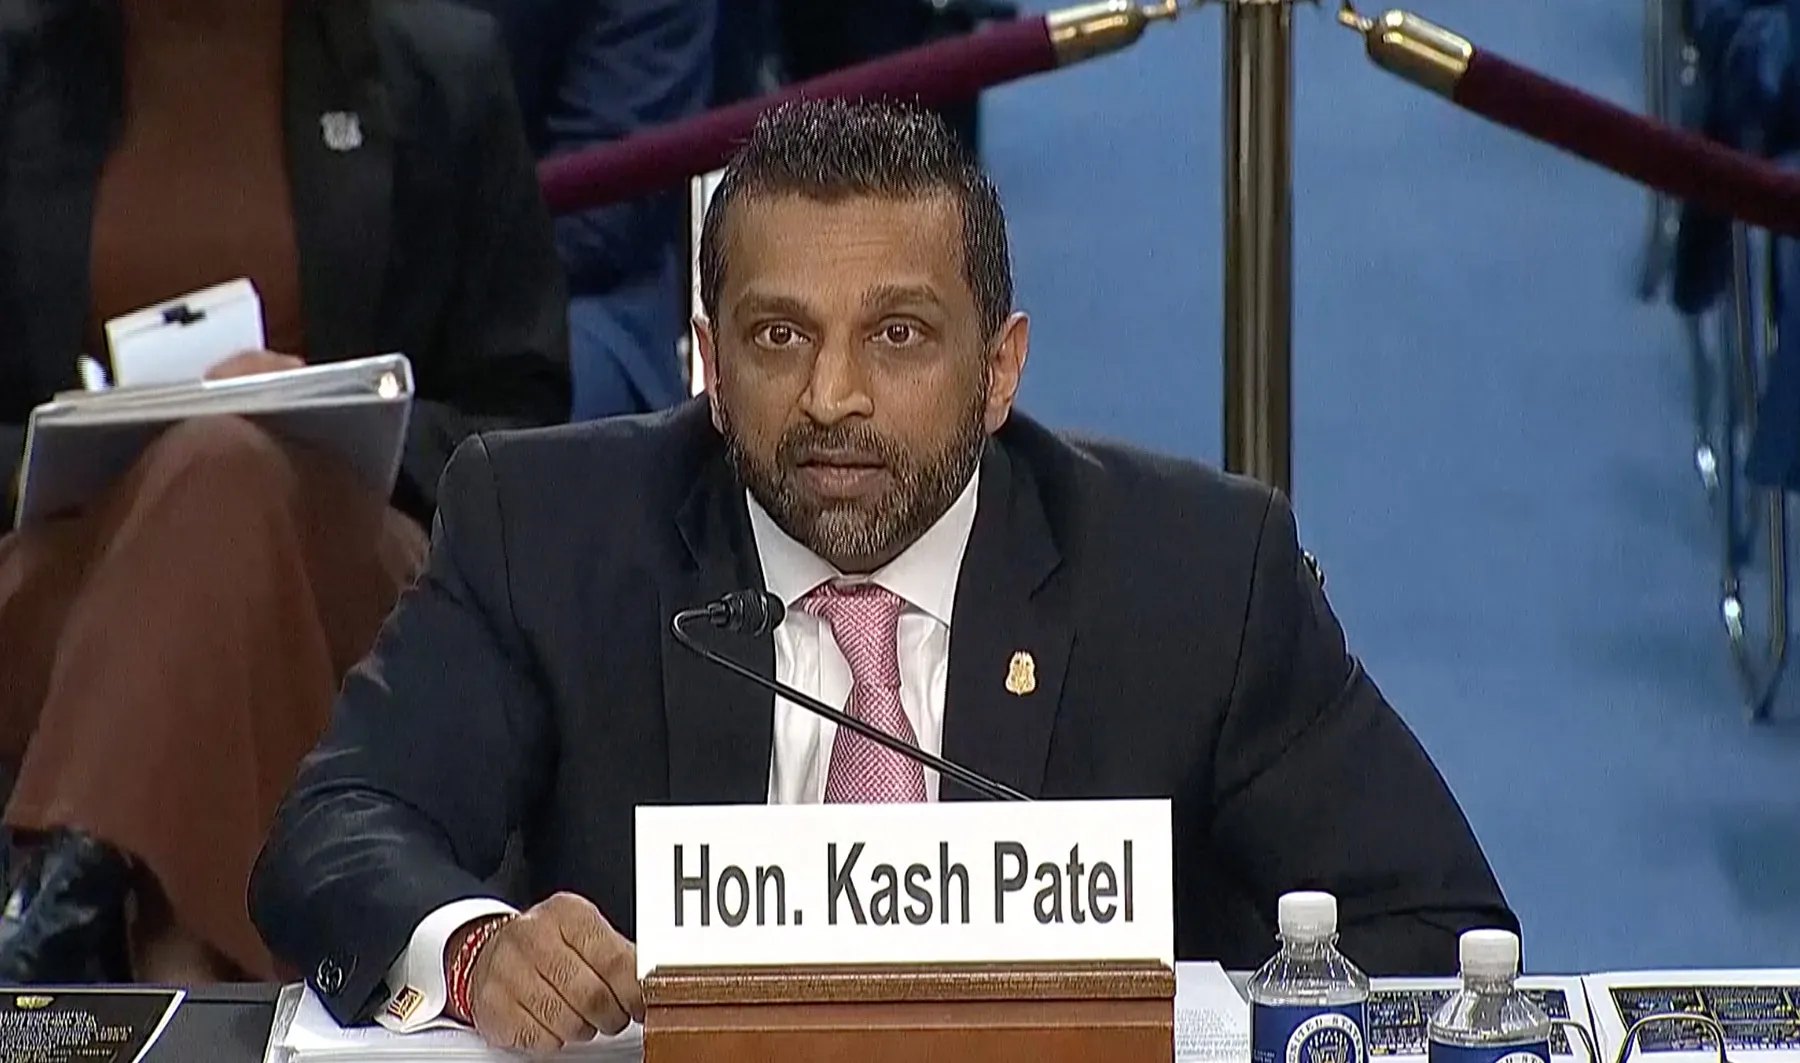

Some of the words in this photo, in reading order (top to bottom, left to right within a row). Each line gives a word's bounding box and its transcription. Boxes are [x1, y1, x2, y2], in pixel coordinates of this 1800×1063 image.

[673, 843, 803, 927] Hon.
[827, 841, 970, 926] Kash
[994, 839, 1134, 925] Patel
